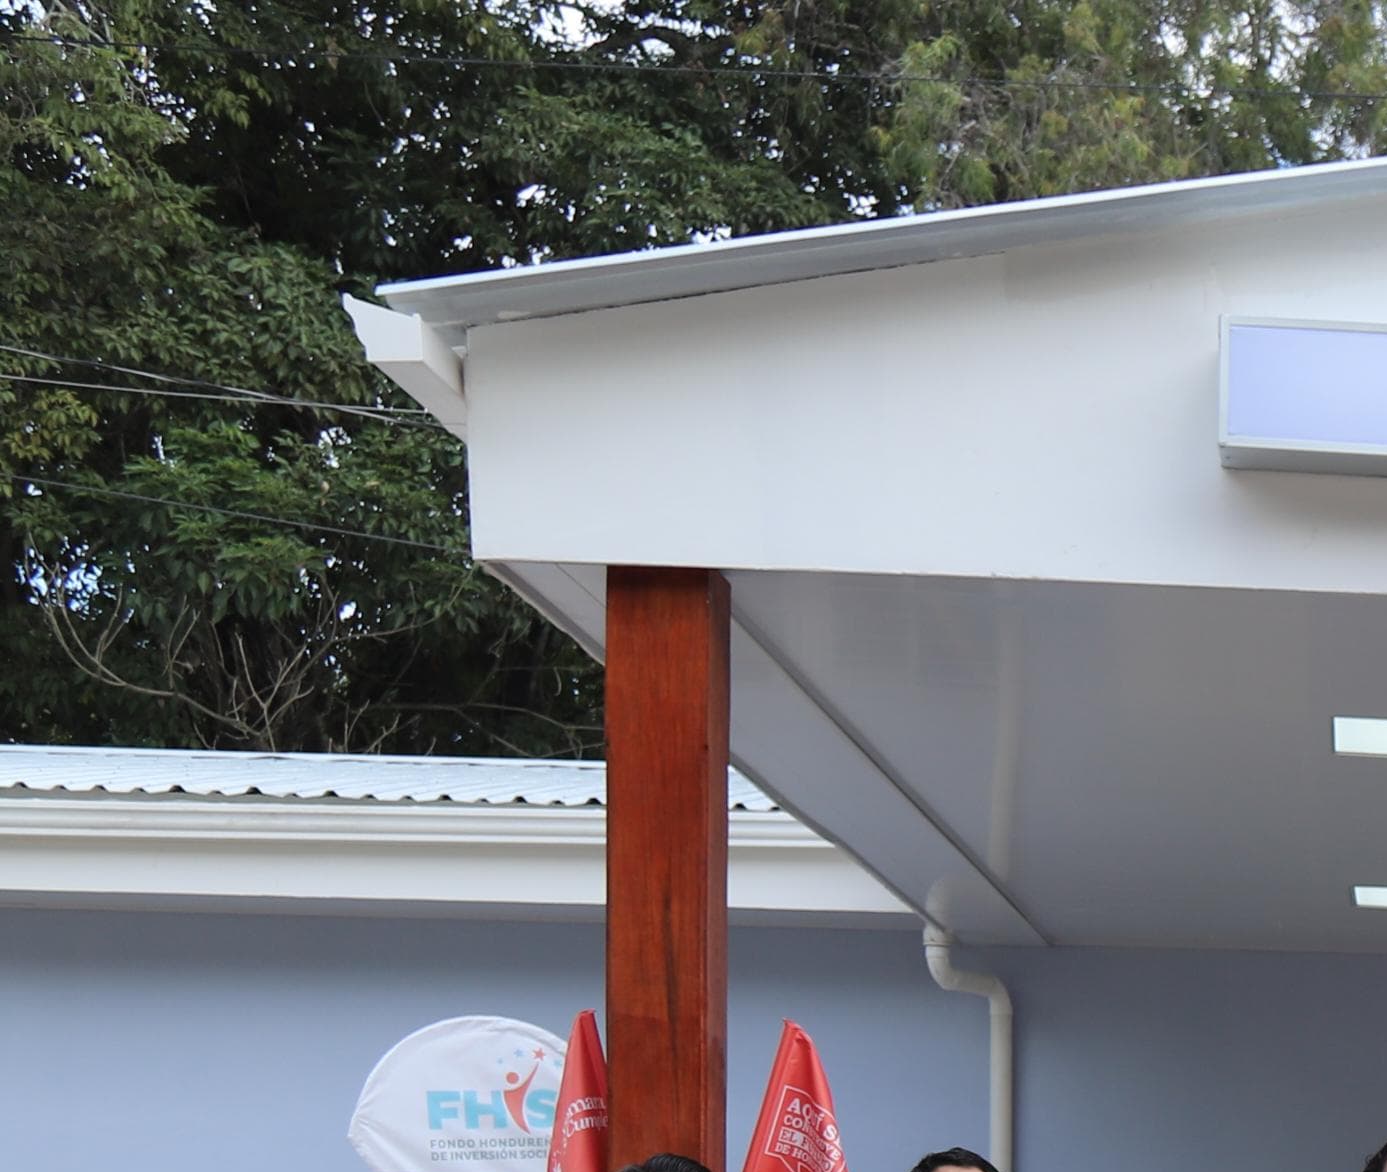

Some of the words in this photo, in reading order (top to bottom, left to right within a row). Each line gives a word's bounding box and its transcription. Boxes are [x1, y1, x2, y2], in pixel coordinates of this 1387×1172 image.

[430, 1139, 476, 1149] FONDO
[431, 1151, 448, 1161] DE
[450, 1147, 518, 1161] INVERSIÓN
[520, 1149, 548, 1160] SOCI
